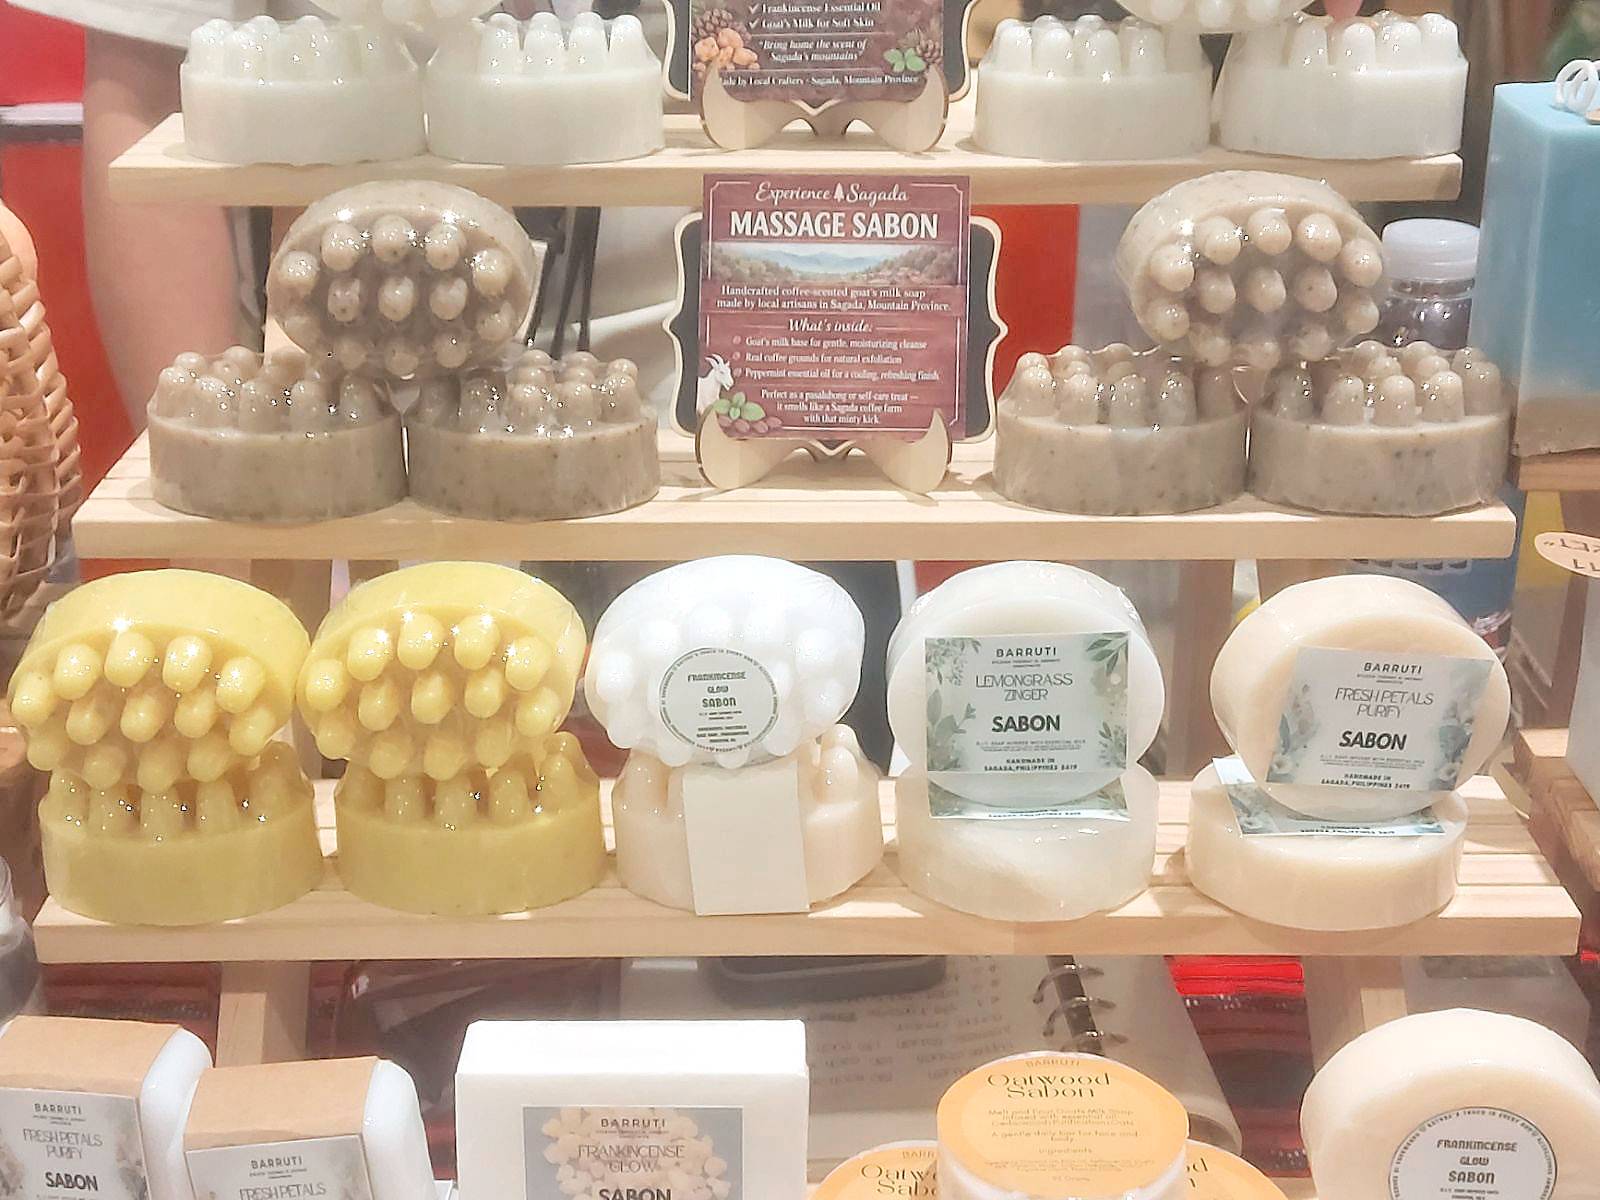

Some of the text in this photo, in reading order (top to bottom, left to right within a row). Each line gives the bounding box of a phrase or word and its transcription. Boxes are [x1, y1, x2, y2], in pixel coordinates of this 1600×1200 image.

[762, 2, 881, 13] Frankincense Essential Oil
[762, 18, 874, 29] Goat's Milk for Soft Skin
[790, 40, 814, 49] home
[816, 40, 829, 49] the
[830, 40, 854, 49] scent
[857, 39, 868, 51] of
[771, 52, 809, 62] Sagada's
[737, 77, 746, 87] by
[750, 76, 770, 85] Local
[772, 76, 804, 85] Crafters
[811, 76, 841, 86] Sagada,
[844, 76, 882, 84] Mountain
[884, 75, 919, 84] Province
[755, 182, 908, 208] Experience Sagada
[730, 210, 938, 239] MASSAGE SABON
[721, 286, 926, 300] Handcrafted coffee-scented goat's milk soap
[716, 299, 742, 308] made
[744, 300, 756, 310] by
[758, 300, 779, 309] local
[781, 300, 817, 309] artisans
[819, 300, 829, 309] in
[830, 300, 865, 312] Sagada,
[867, 300, 908, 311] Mountain
[788, 318, 831, 332] What's
[745, 337, 927, 350] Goat's milk base for gentle, moisturizing cleanse
[745, 354, 902, 365] Real coffee grounds for natural exfoliation
[745, 368, 786, 380] Peppermint
[788, 369, 818, 378] essential
[820, 369, 830, 378] oil
[831, 369, 843, 379] for
[844, 371, 850, 379] a
[881, 371, 916, 382] refreshing
[918, 371, 939, 381] finish
[761, 390, 787, 399] Perfect
[848, 392, 857, 400] or
[858, 391, 890, 401] self-care
[891, 392, 908, 401] treat
[776, 402, 783, 411] it
[784, 402, 808, 412] smells
[809, 402, 824, 412] like
[831, 403, 859, 414] Sagada
[859, 404, 883, 412] coffee
[884, 404, 903, 413] farm
[803, 414, 821, 424] with
[822, 414, 837, 424] that
[838, 415, 860, 426] minty
[996, 646, 1057, 658] BARRUTI
[1363, 662, 1422, 675] BARRUTI
[975, 672, 1073, 688] LEMONGRASS
[1004, 688, 1049, 701] ZINGER
[1335, 687, 1435, 706] FRESH PETALS
[702, 698, 737, 708] SABON
[1356, 703, 1401, 719] PURIFY
[991, 715, 1061, 733] SABON
[1339, 730, 1407, 751] SABON
[988, 1072, 1111, 1087] Oatwood
[1007, 1086, 1094, 1099] Sabon
[34, 1103, 82, 1115] BARRUTI
[600, 1118, 666, 1128] BARRUTI
[22, 1128, 104, 1147] FRESH PETALS
[45, 1145, 83, 1160] PURIFY
[578, 1144, 686, 1160] FRANKINCENSE
[1437, 1139, 1519, 1153] FRANKINCENSE
[250, 1156, 303, 1169] BARRUTI
[609, 1160, 656, 1173] GLOW
[1459, 1156, 1490, 1166] GLOW
[45, 1172, 99, 1192] SABON
[1448, 1170, 1495, 1185] SABON
[280, 1182, 327, 1200] PETALS
[599, 1188, 672, 1200] SABON
